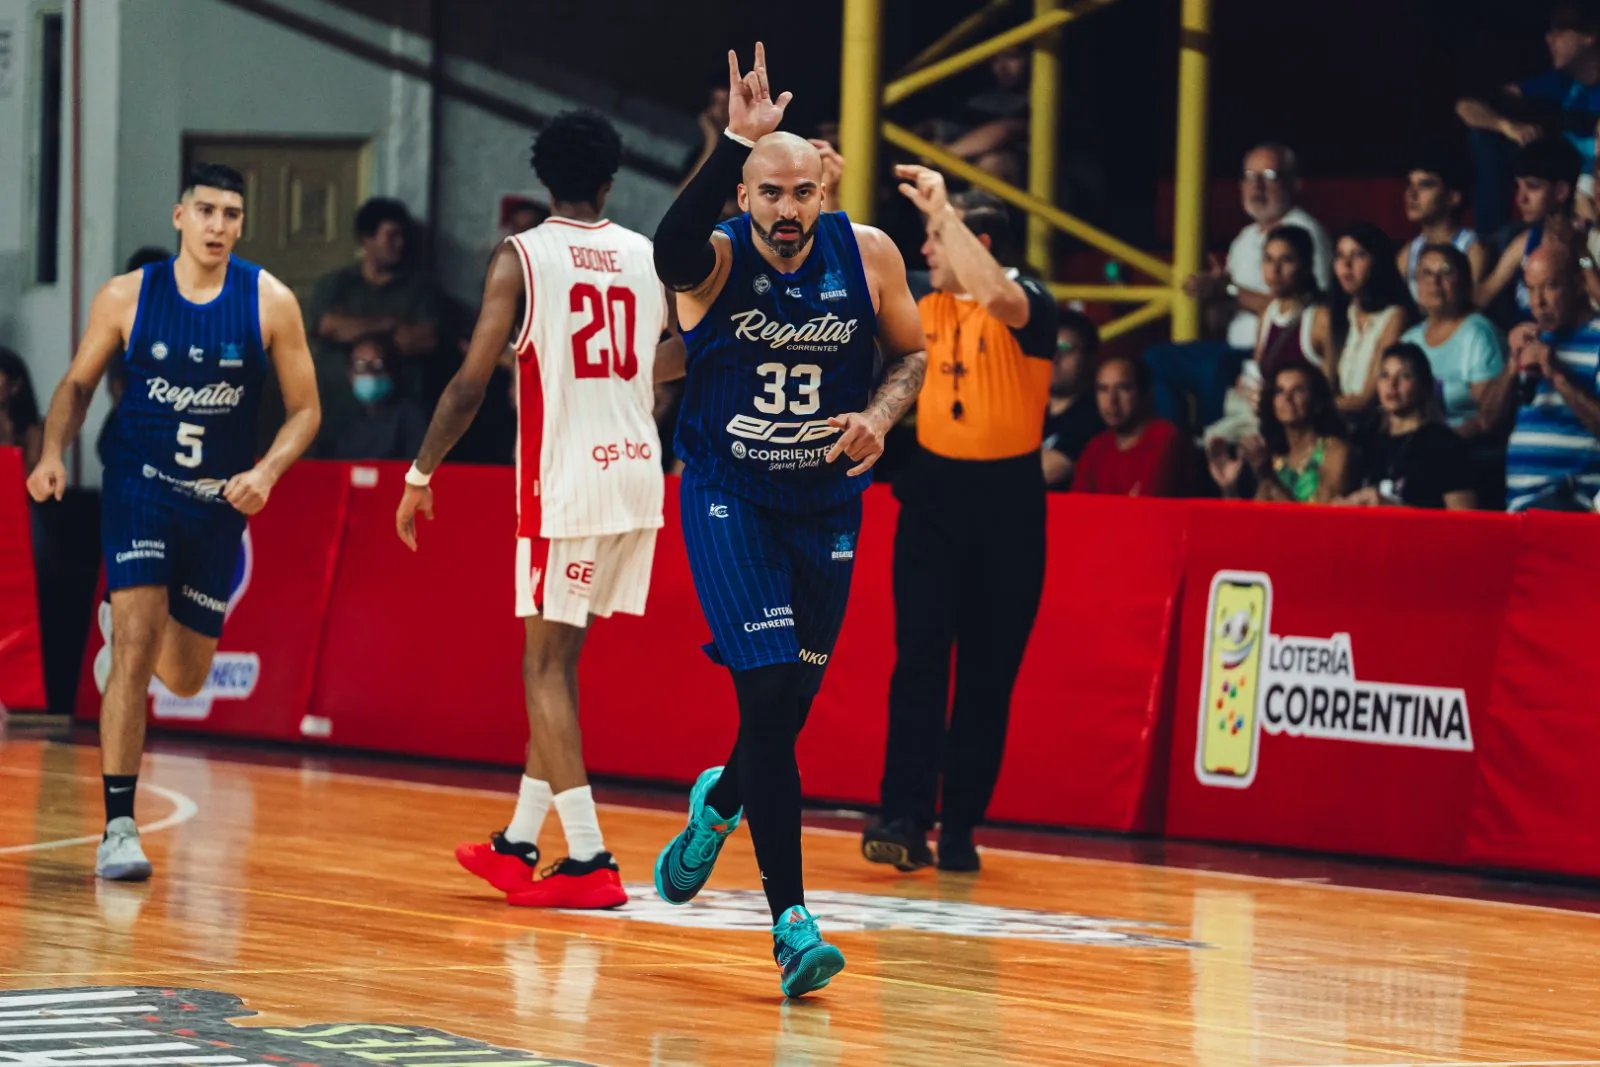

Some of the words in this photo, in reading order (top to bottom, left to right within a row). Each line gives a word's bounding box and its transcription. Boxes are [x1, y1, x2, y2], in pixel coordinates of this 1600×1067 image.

[569, 246, 622, 273] BOONE
[820, 289, 848, 300] REGATAS
[569, 282, 638, 381] 20
[730, 308, 858, 349] Regatas
[786, 344, 838, 352] CORRIENTES
[146, 376, 243, 412] Regatas
[753, 362, 823, 416] 33
[174, 421, 205, 468] 5
[1269, 642, 1349, 675] LOTERÍA
[1265, 683, 1466, 740] CORRENTINA
